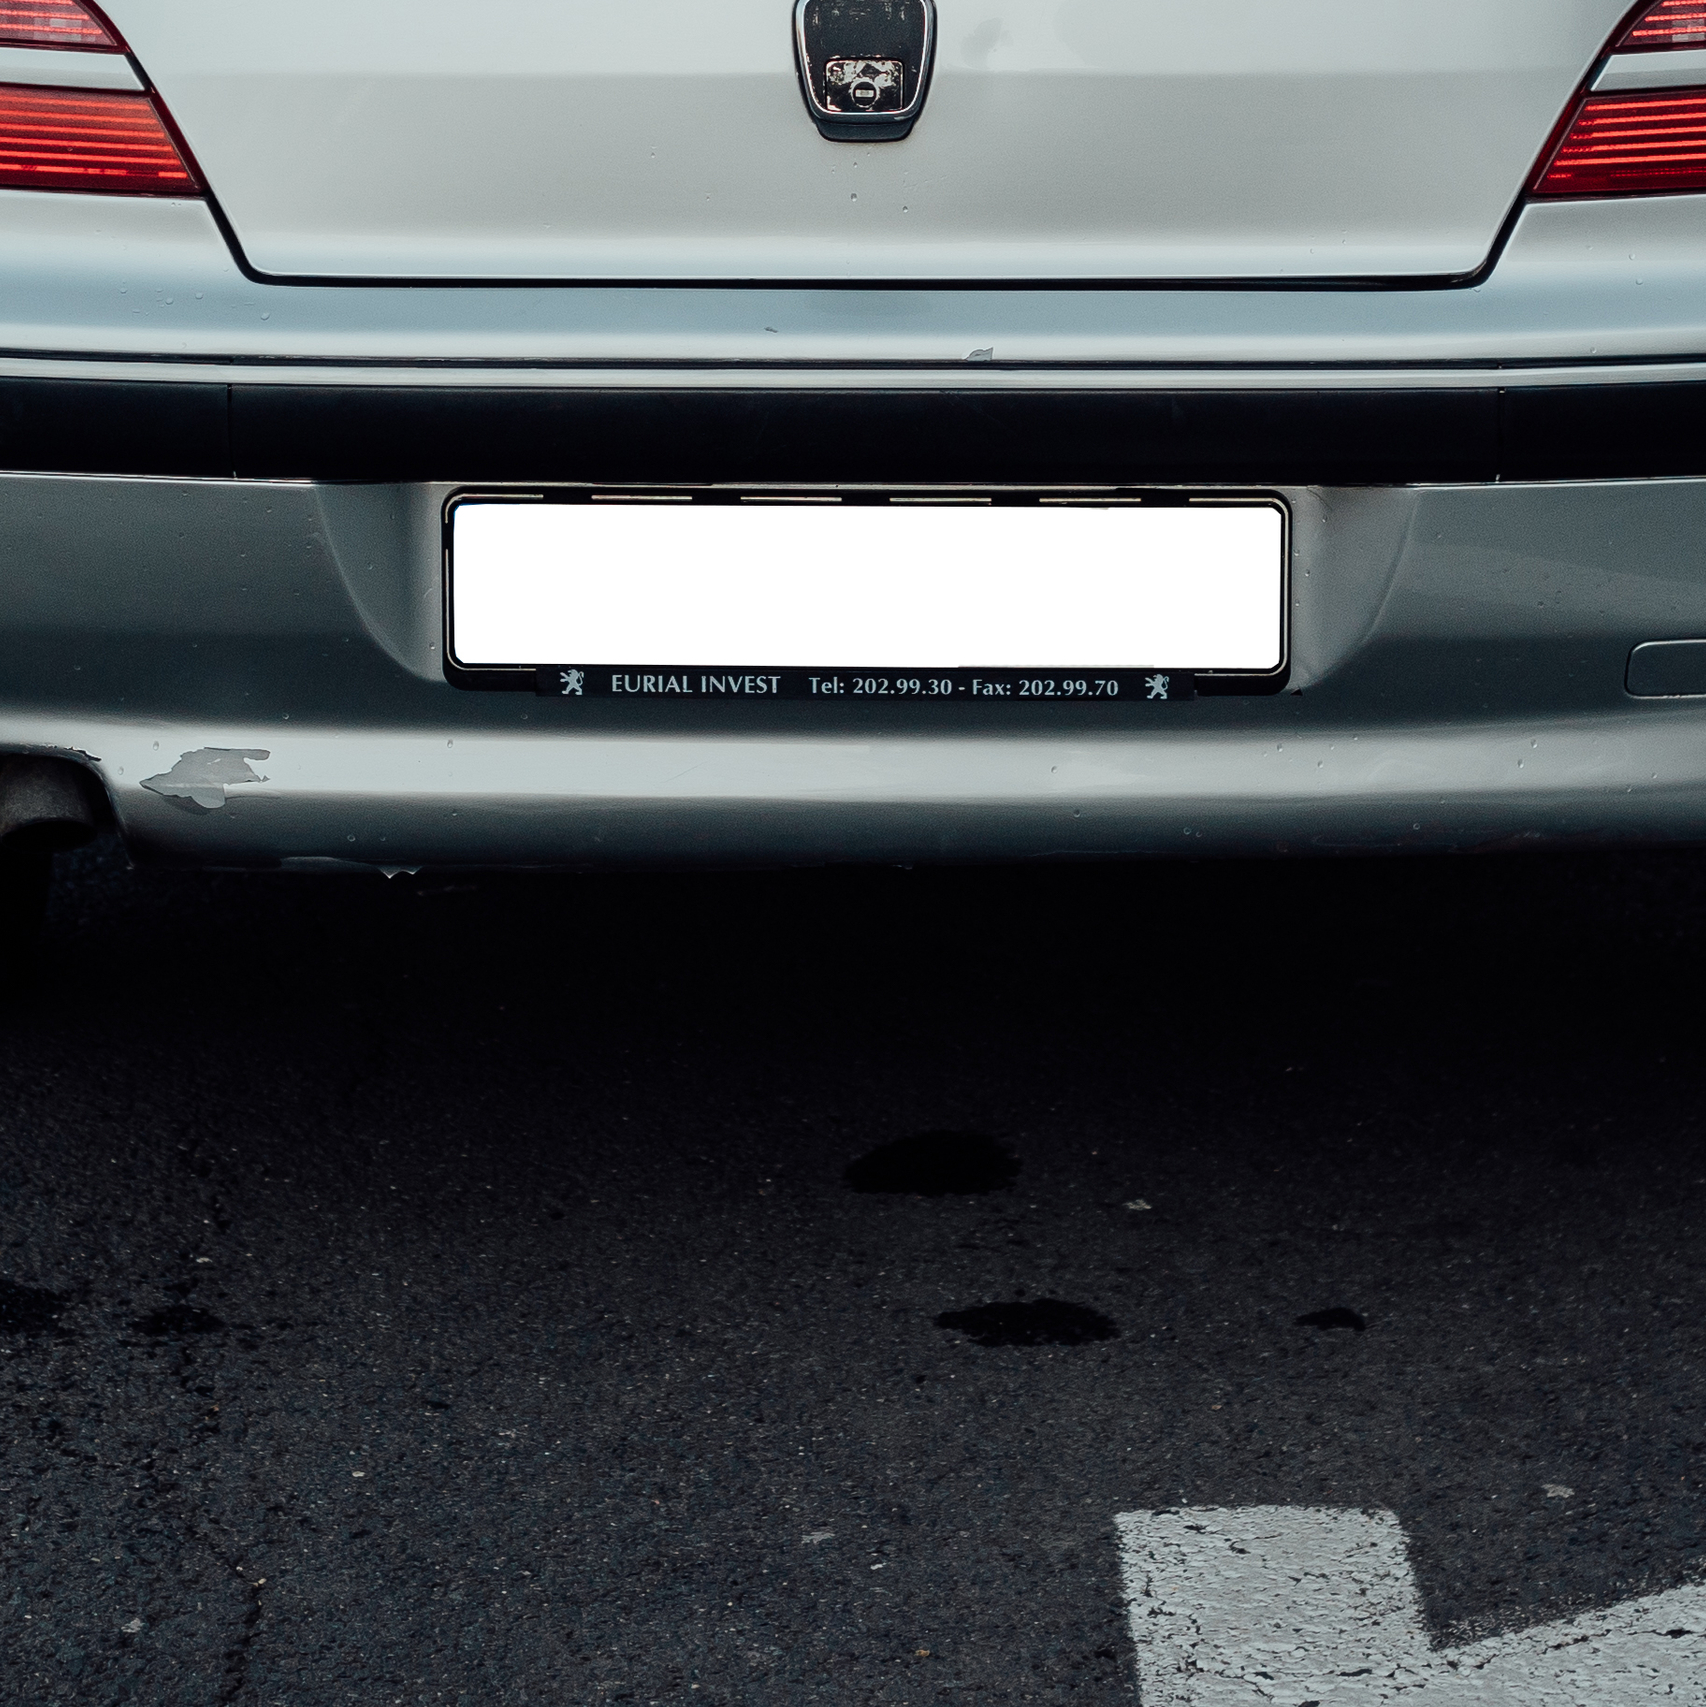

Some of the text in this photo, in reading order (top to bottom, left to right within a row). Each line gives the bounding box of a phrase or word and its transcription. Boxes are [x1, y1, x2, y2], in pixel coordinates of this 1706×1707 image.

[611, 674, 694, 694] EURIAL
[700, 675, 782, 695] INVEST
[808, 675, 846, 695] Tel:
[852, 677, 953, 696] 202.99.30
[971, 678, 1012, 697] Fax:
[1018, 678, 1120, 697] 202.99.70
